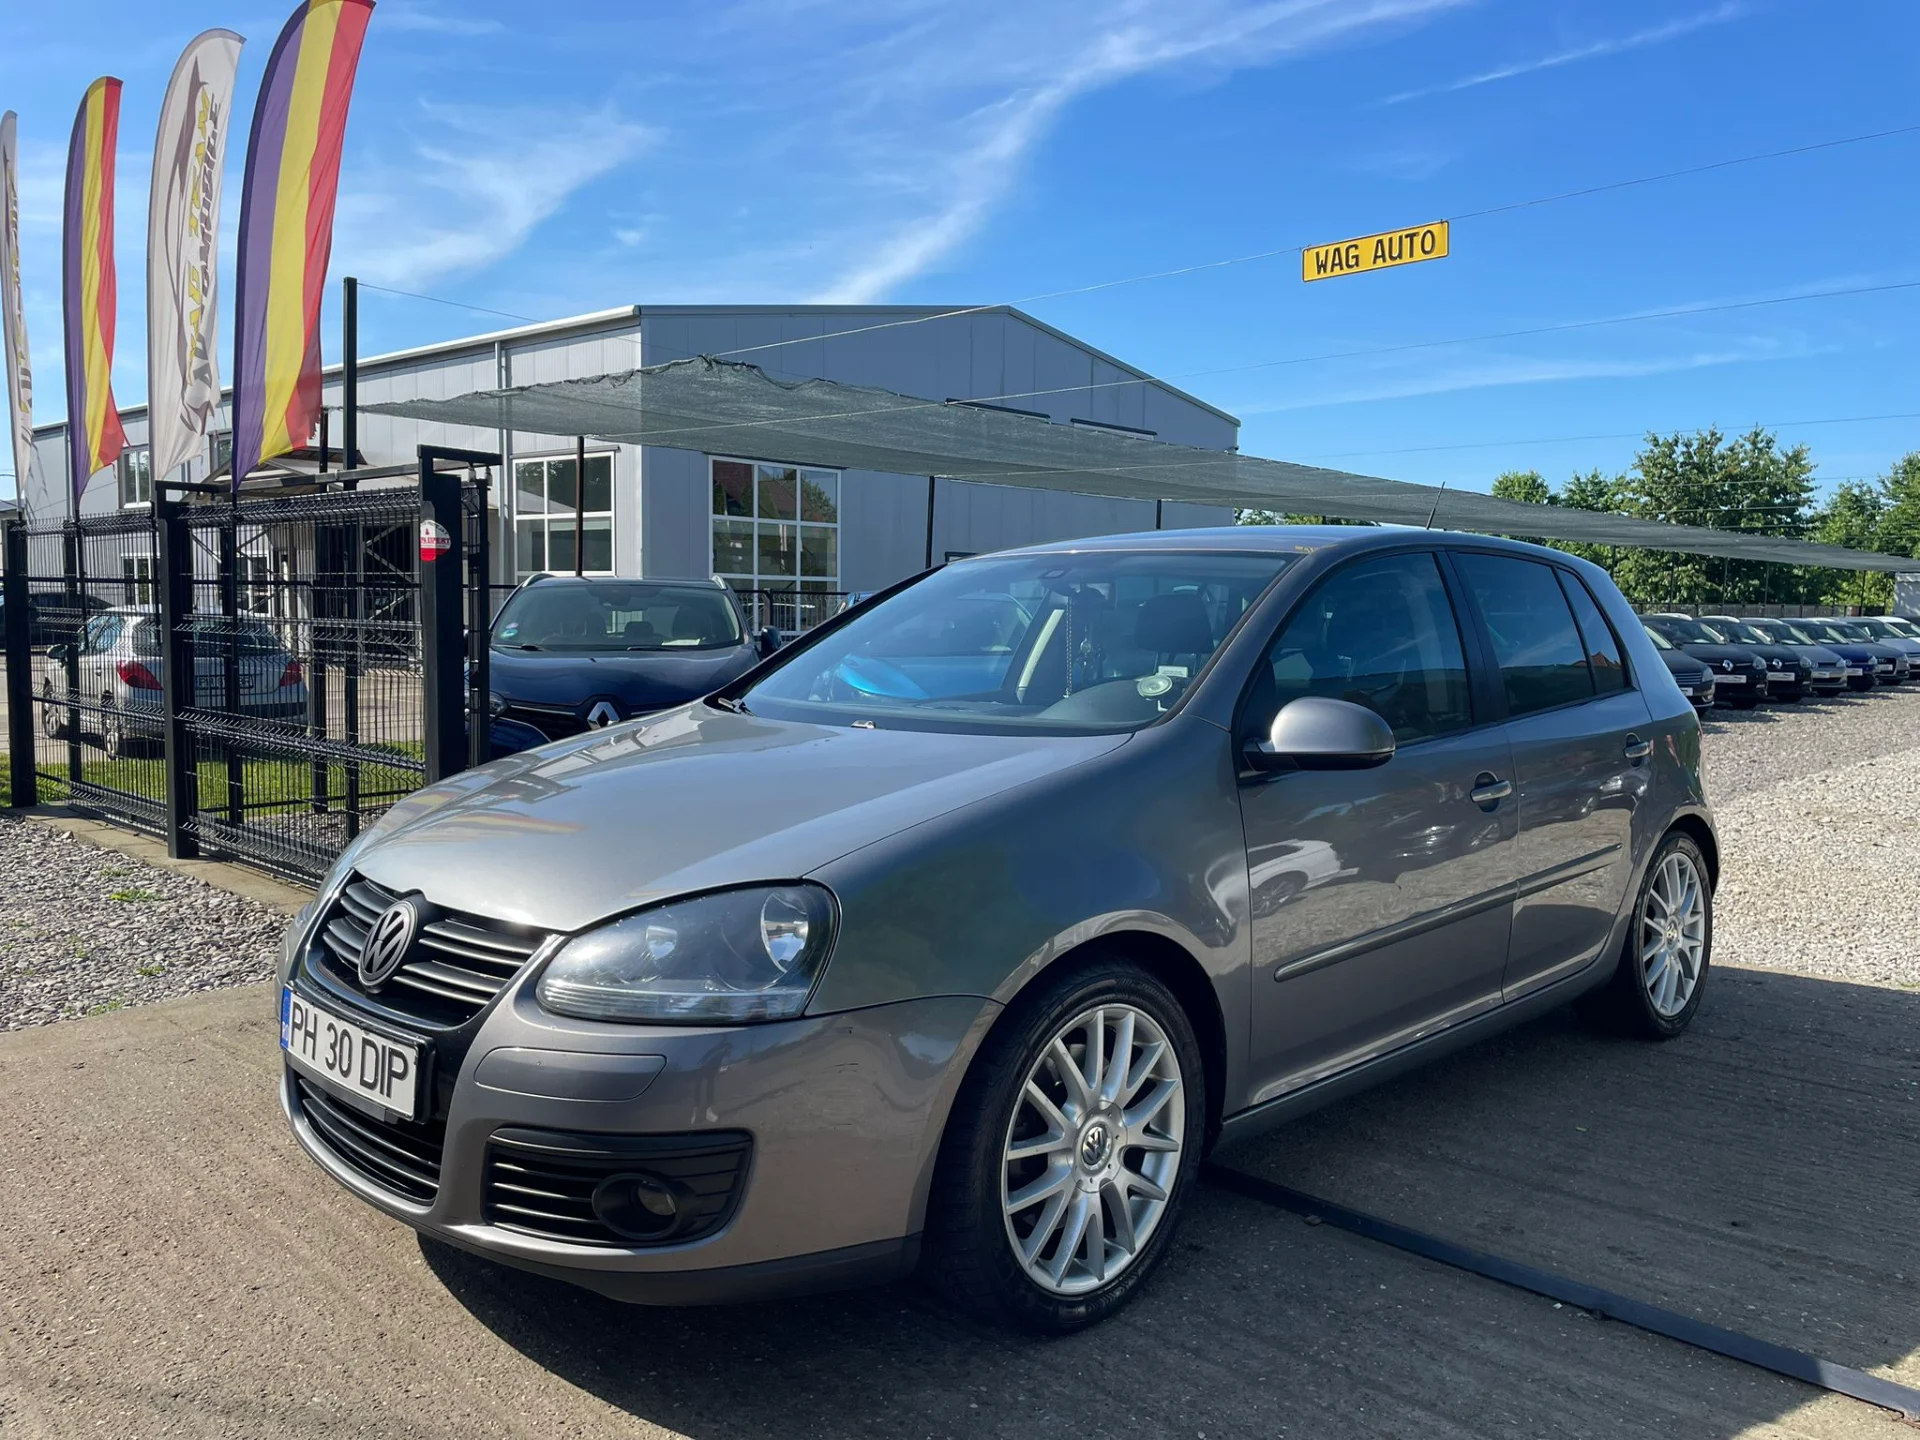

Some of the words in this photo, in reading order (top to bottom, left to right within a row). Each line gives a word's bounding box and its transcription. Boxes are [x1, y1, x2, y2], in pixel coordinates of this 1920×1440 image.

[192, 92, 222, 390] AUOMOBILE
[1315, 243, 1360, 275] WAG
[1372, 229, 1436, 265] AUTO
[290, 1000, 319, 1061] PH
[325, 1021, 354, 1079] 30
[359, 1036, 409, 1100] DIP
